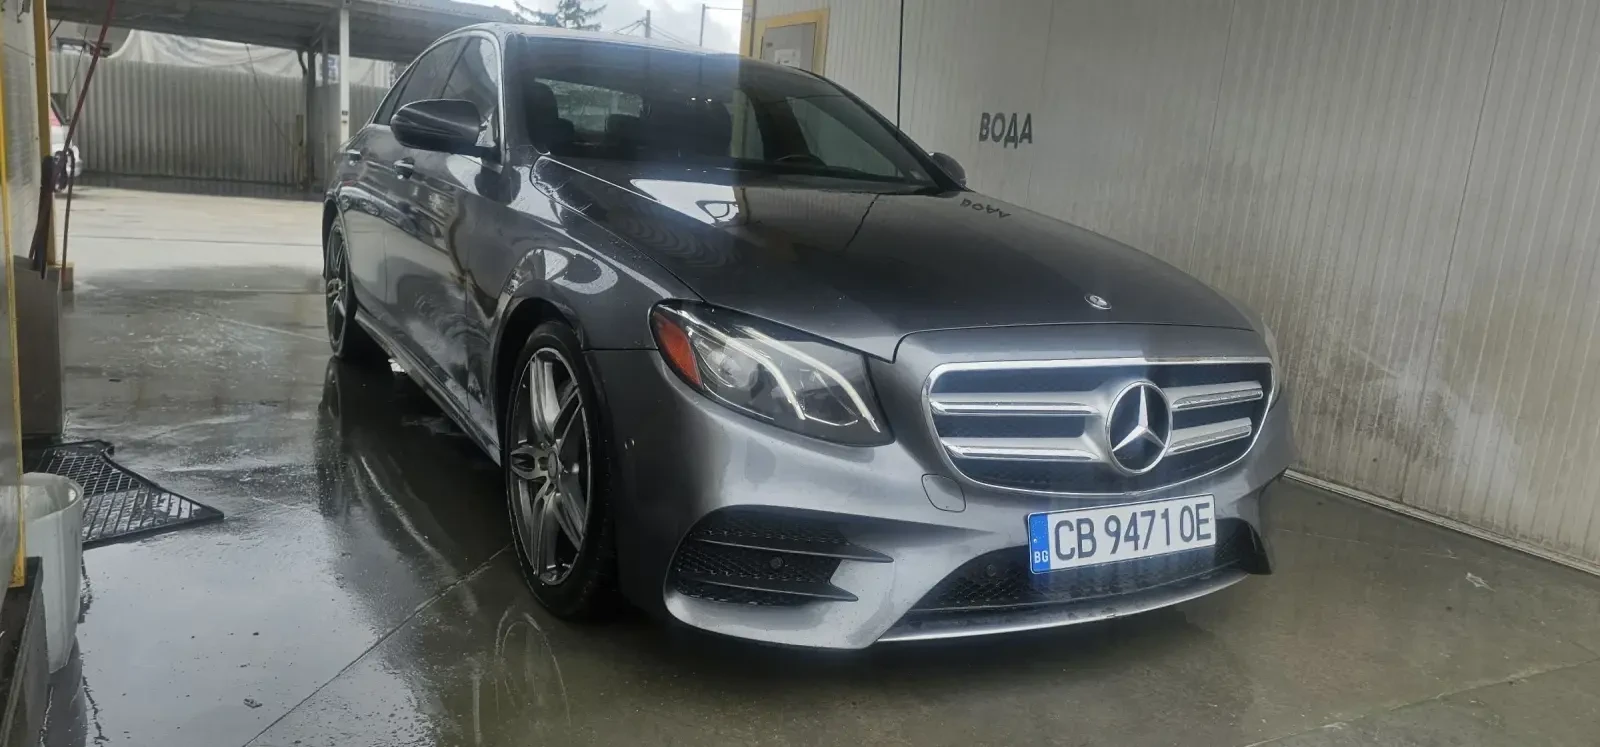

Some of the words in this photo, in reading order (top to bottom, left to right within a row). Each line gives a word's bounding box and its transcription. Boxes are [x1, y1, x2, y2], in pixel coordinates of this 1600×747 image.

[979, 112, 1033, 149] ВОДА
[1054, 517, 1097, 561] CB
[1104, 508, 1171, 555] 9471
[1033, 551, 1049, 564] BG
